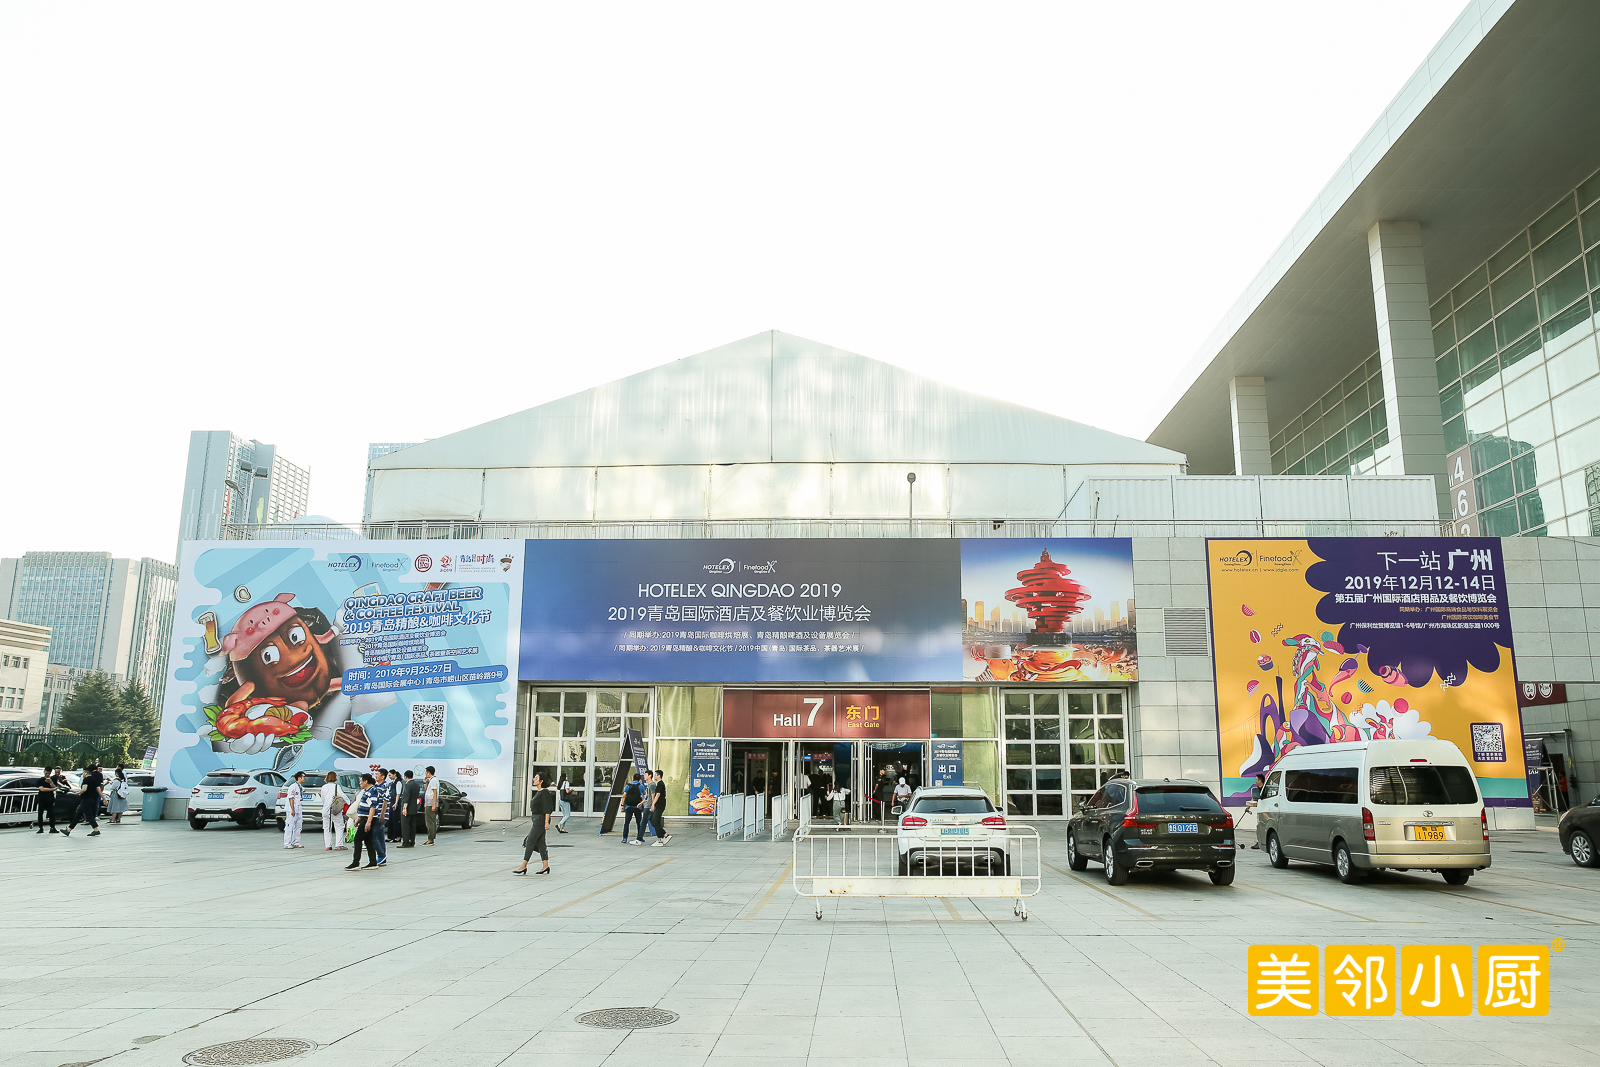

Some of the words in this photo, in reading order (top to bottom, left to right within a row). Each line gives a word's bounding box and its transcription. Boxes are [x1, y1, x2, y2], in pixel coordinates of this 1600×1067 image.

[1454, 456, 1465, 482] 4
[1457, 489, 1469, 517] 6
[1376, 550, 1441, 571] 下一站
[1447, 548, 1493, 571] 广州
[638, 583, 707, 598] HOTELEX
[711, 583, 795, 598] QINGDAO
[800, 583, 842, 598] 2019
[1344, 574, 1496, 591] 2019年12月12-14日
[345, 594, 405, 610] QINGDAO
[406, 590, 448, 604] CRAFT
[448, 587, 481, 600] BEER
[1334, 593, 1497, 604] 第五届广州国际酒店用品及餐饮博览会
[343, 609, 355, 621] &
[357, 606, 404, 619] COFFEE
[405, 601, 460, 616] FESTIVAL
[607, 604, 872, 622] 2019青岛国际酒店及餐饮业博览会
[342, 609, 492, 635] 2019青岛精酿&咖啡文化节
[773, 713, 801, 727] Hall
[803, 697, 824, 727] 7
[846, 705, 880, 721] 东门
[697, 763, 715, 772] 入口
[938, 764, 957, 773] 出口
